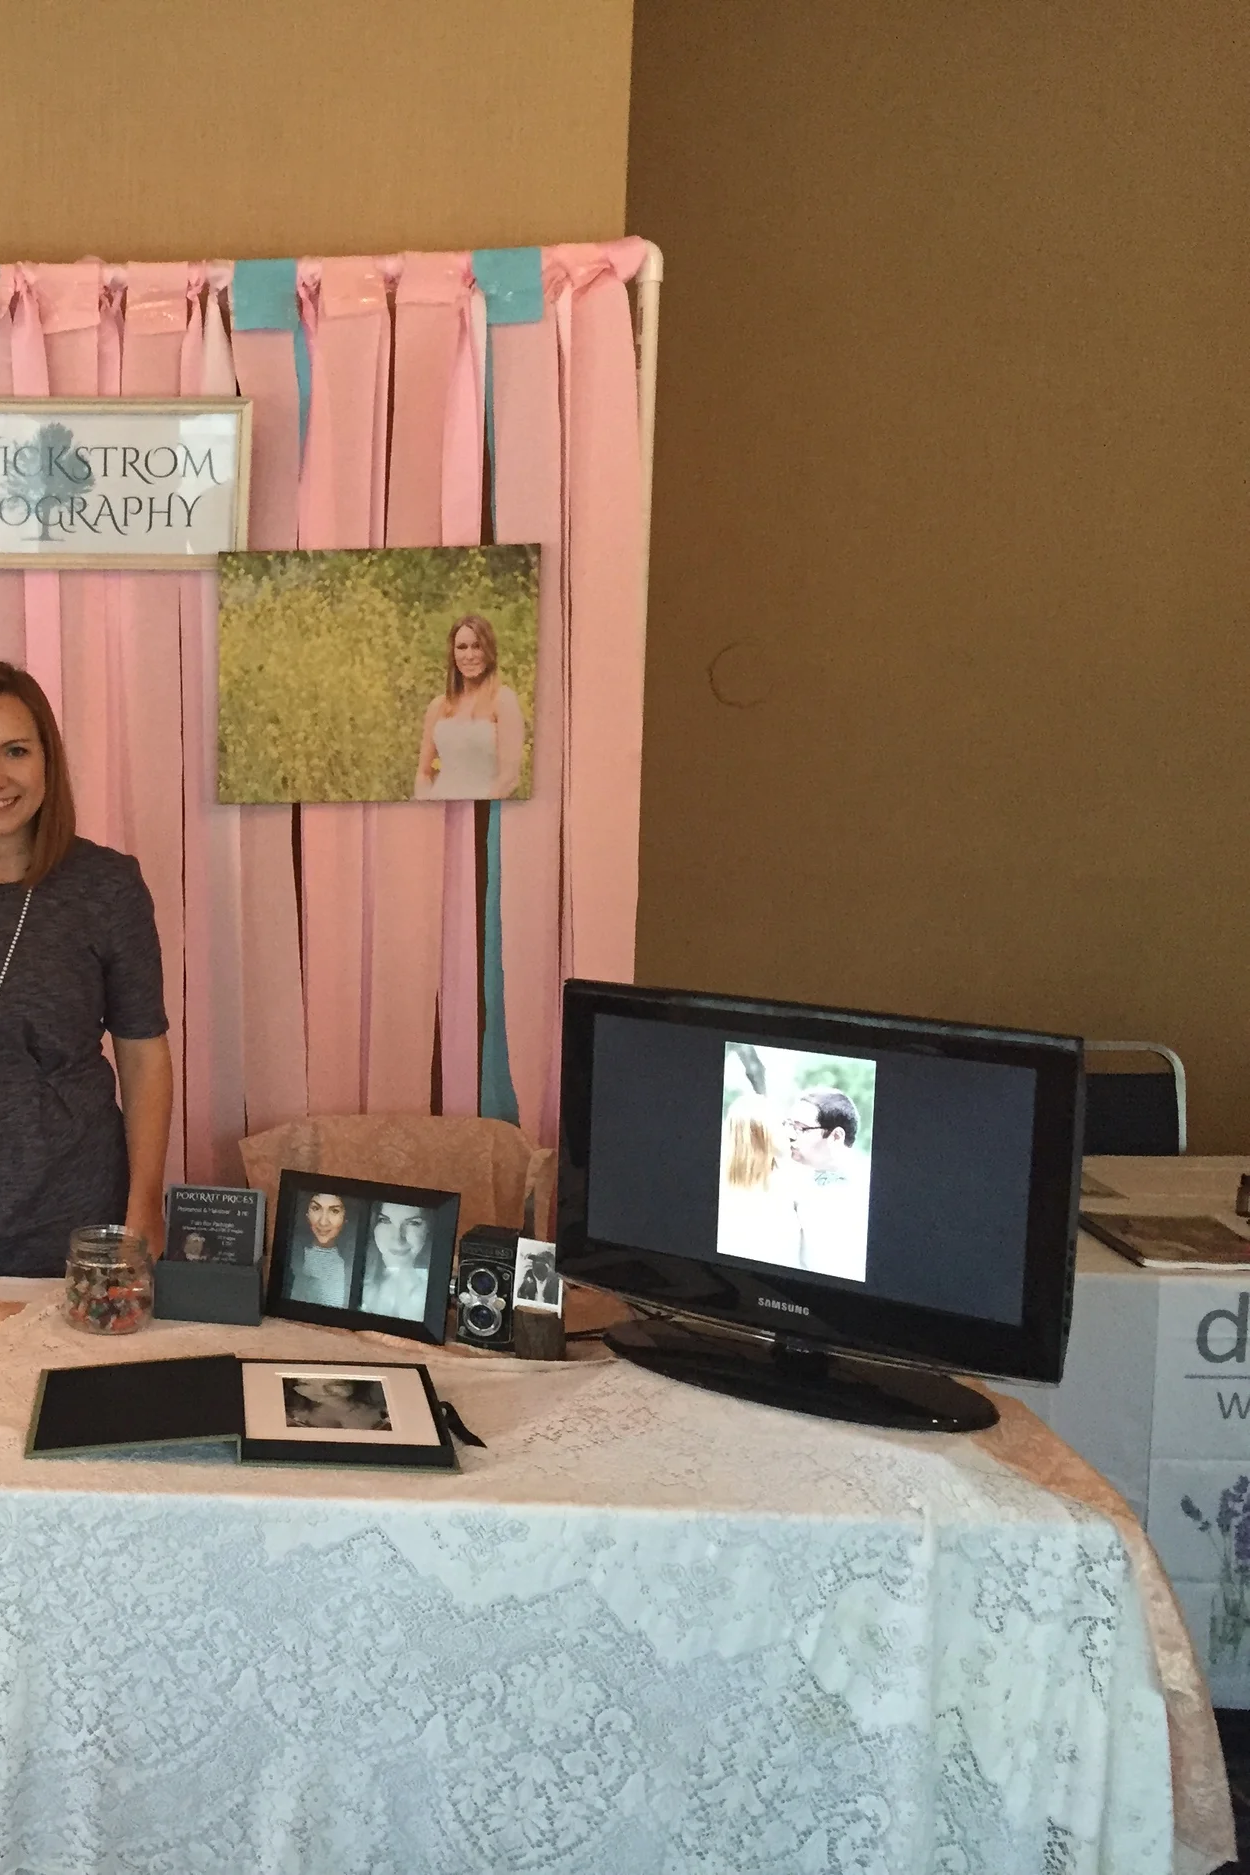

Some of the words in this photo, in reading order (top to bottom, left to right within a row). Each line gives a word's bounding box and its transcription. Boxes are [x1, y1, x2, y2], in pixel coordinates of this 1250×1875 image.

[176, 1191, 221, 1204] PORTRAIT
[222, 1193, 254, 1205] PRICES
[757, 1297, 810, 1316] SAMSUNG
